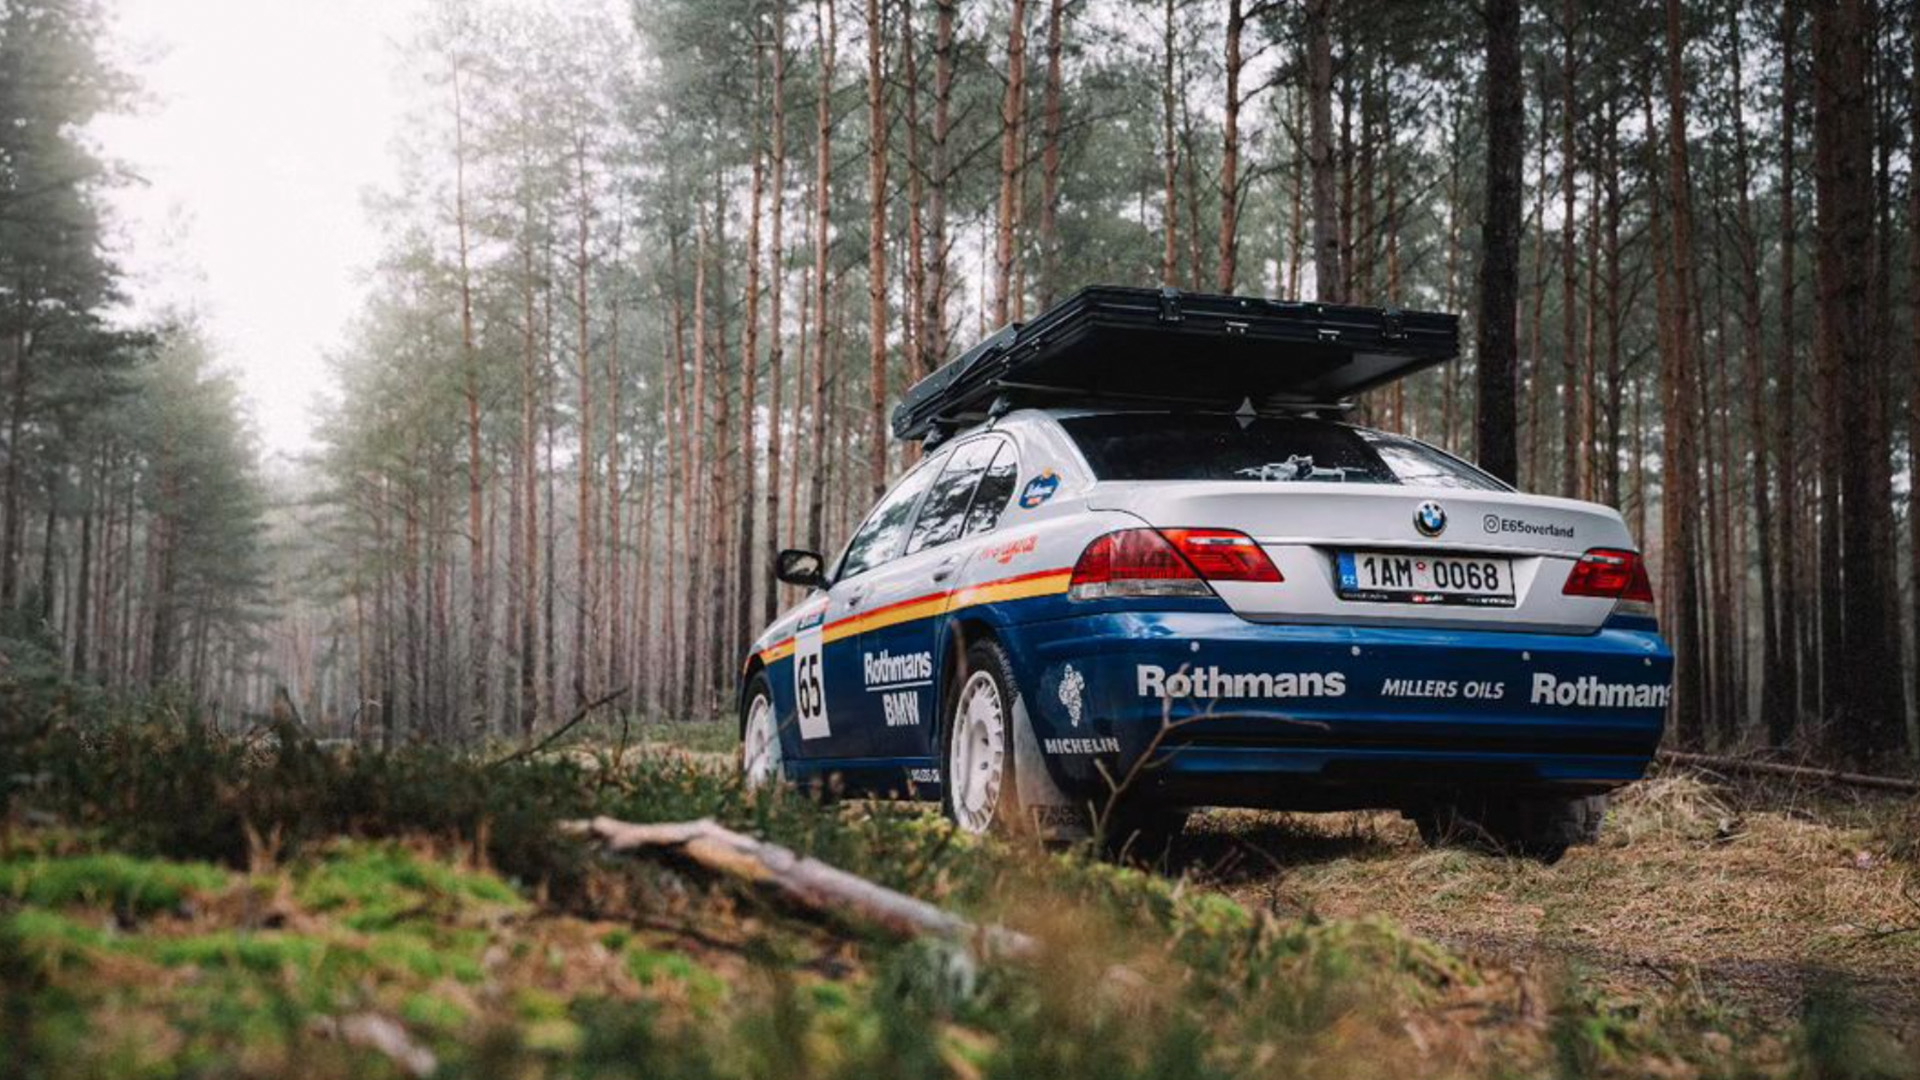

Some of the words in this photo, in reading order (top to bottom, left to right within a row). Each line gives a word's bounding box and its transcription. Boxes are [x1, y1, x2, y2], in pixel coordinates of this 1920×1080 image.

[1501, 519, 1574, 538] E65overland
[1363, 556, 1413, 587] 1AM
[1433, 561, 1499, 590] 0068
[863, 649, 932, 685] Rothmans
[1136, 664, 1346, 698] Rothmans
[798, 653, 821, 719] 65
[1381, 678, 1457, 698] MILLERS
[1463, 681, 1504, 699] OILS
[882, 691, 919, 727] BMW
[1044, 737, 1120, 754] MICHELIN
